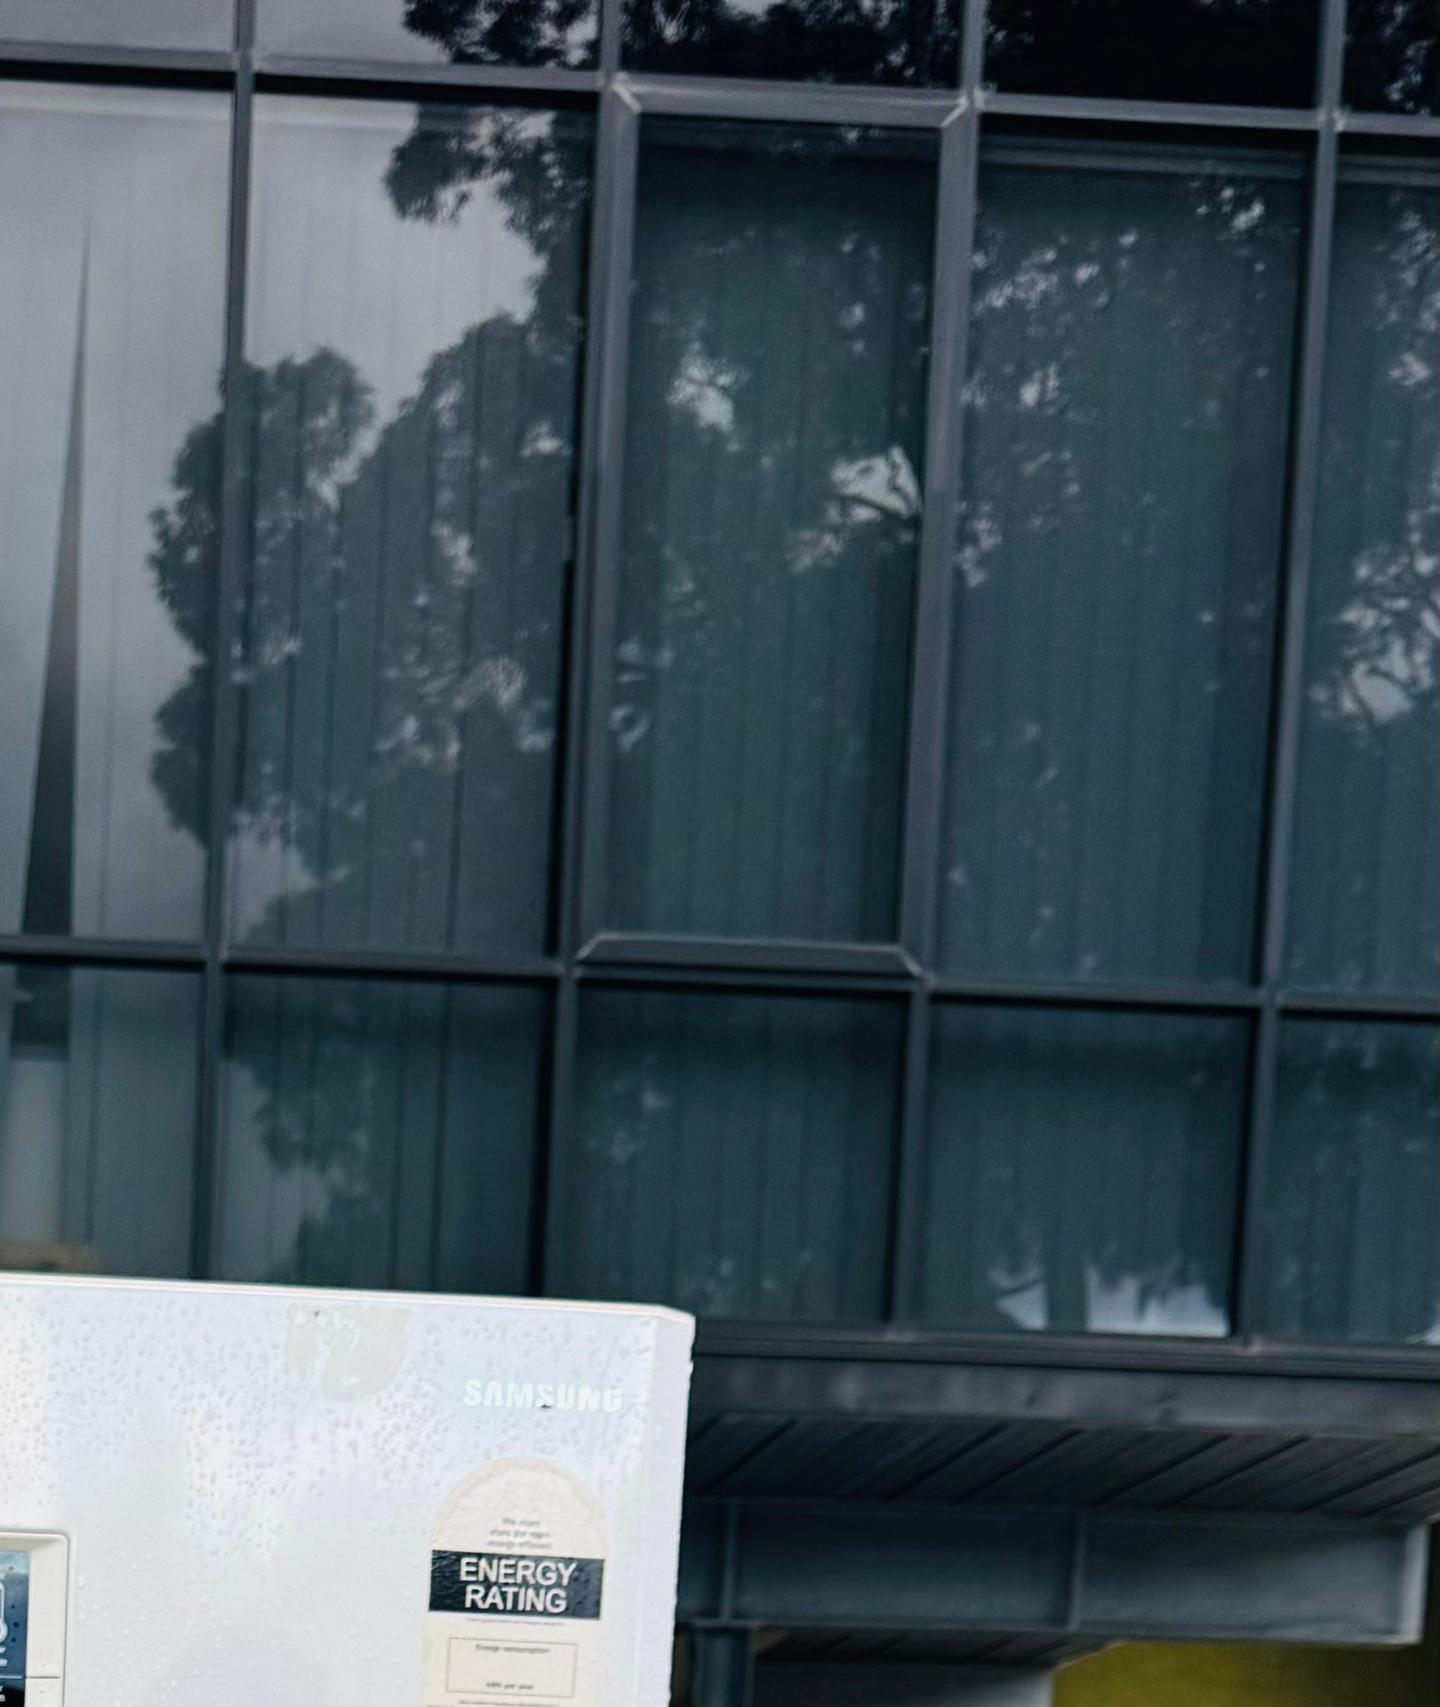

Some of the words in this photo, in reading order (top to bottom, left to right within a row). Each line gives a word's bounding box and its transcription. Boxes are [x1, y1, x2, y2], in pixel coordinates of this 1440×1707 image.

[464, 1378, 624, 1412] SAMSUNG
[460, 1557, 578, 1586] ENERGY
[464, 1585, 568, 1614] RATING
